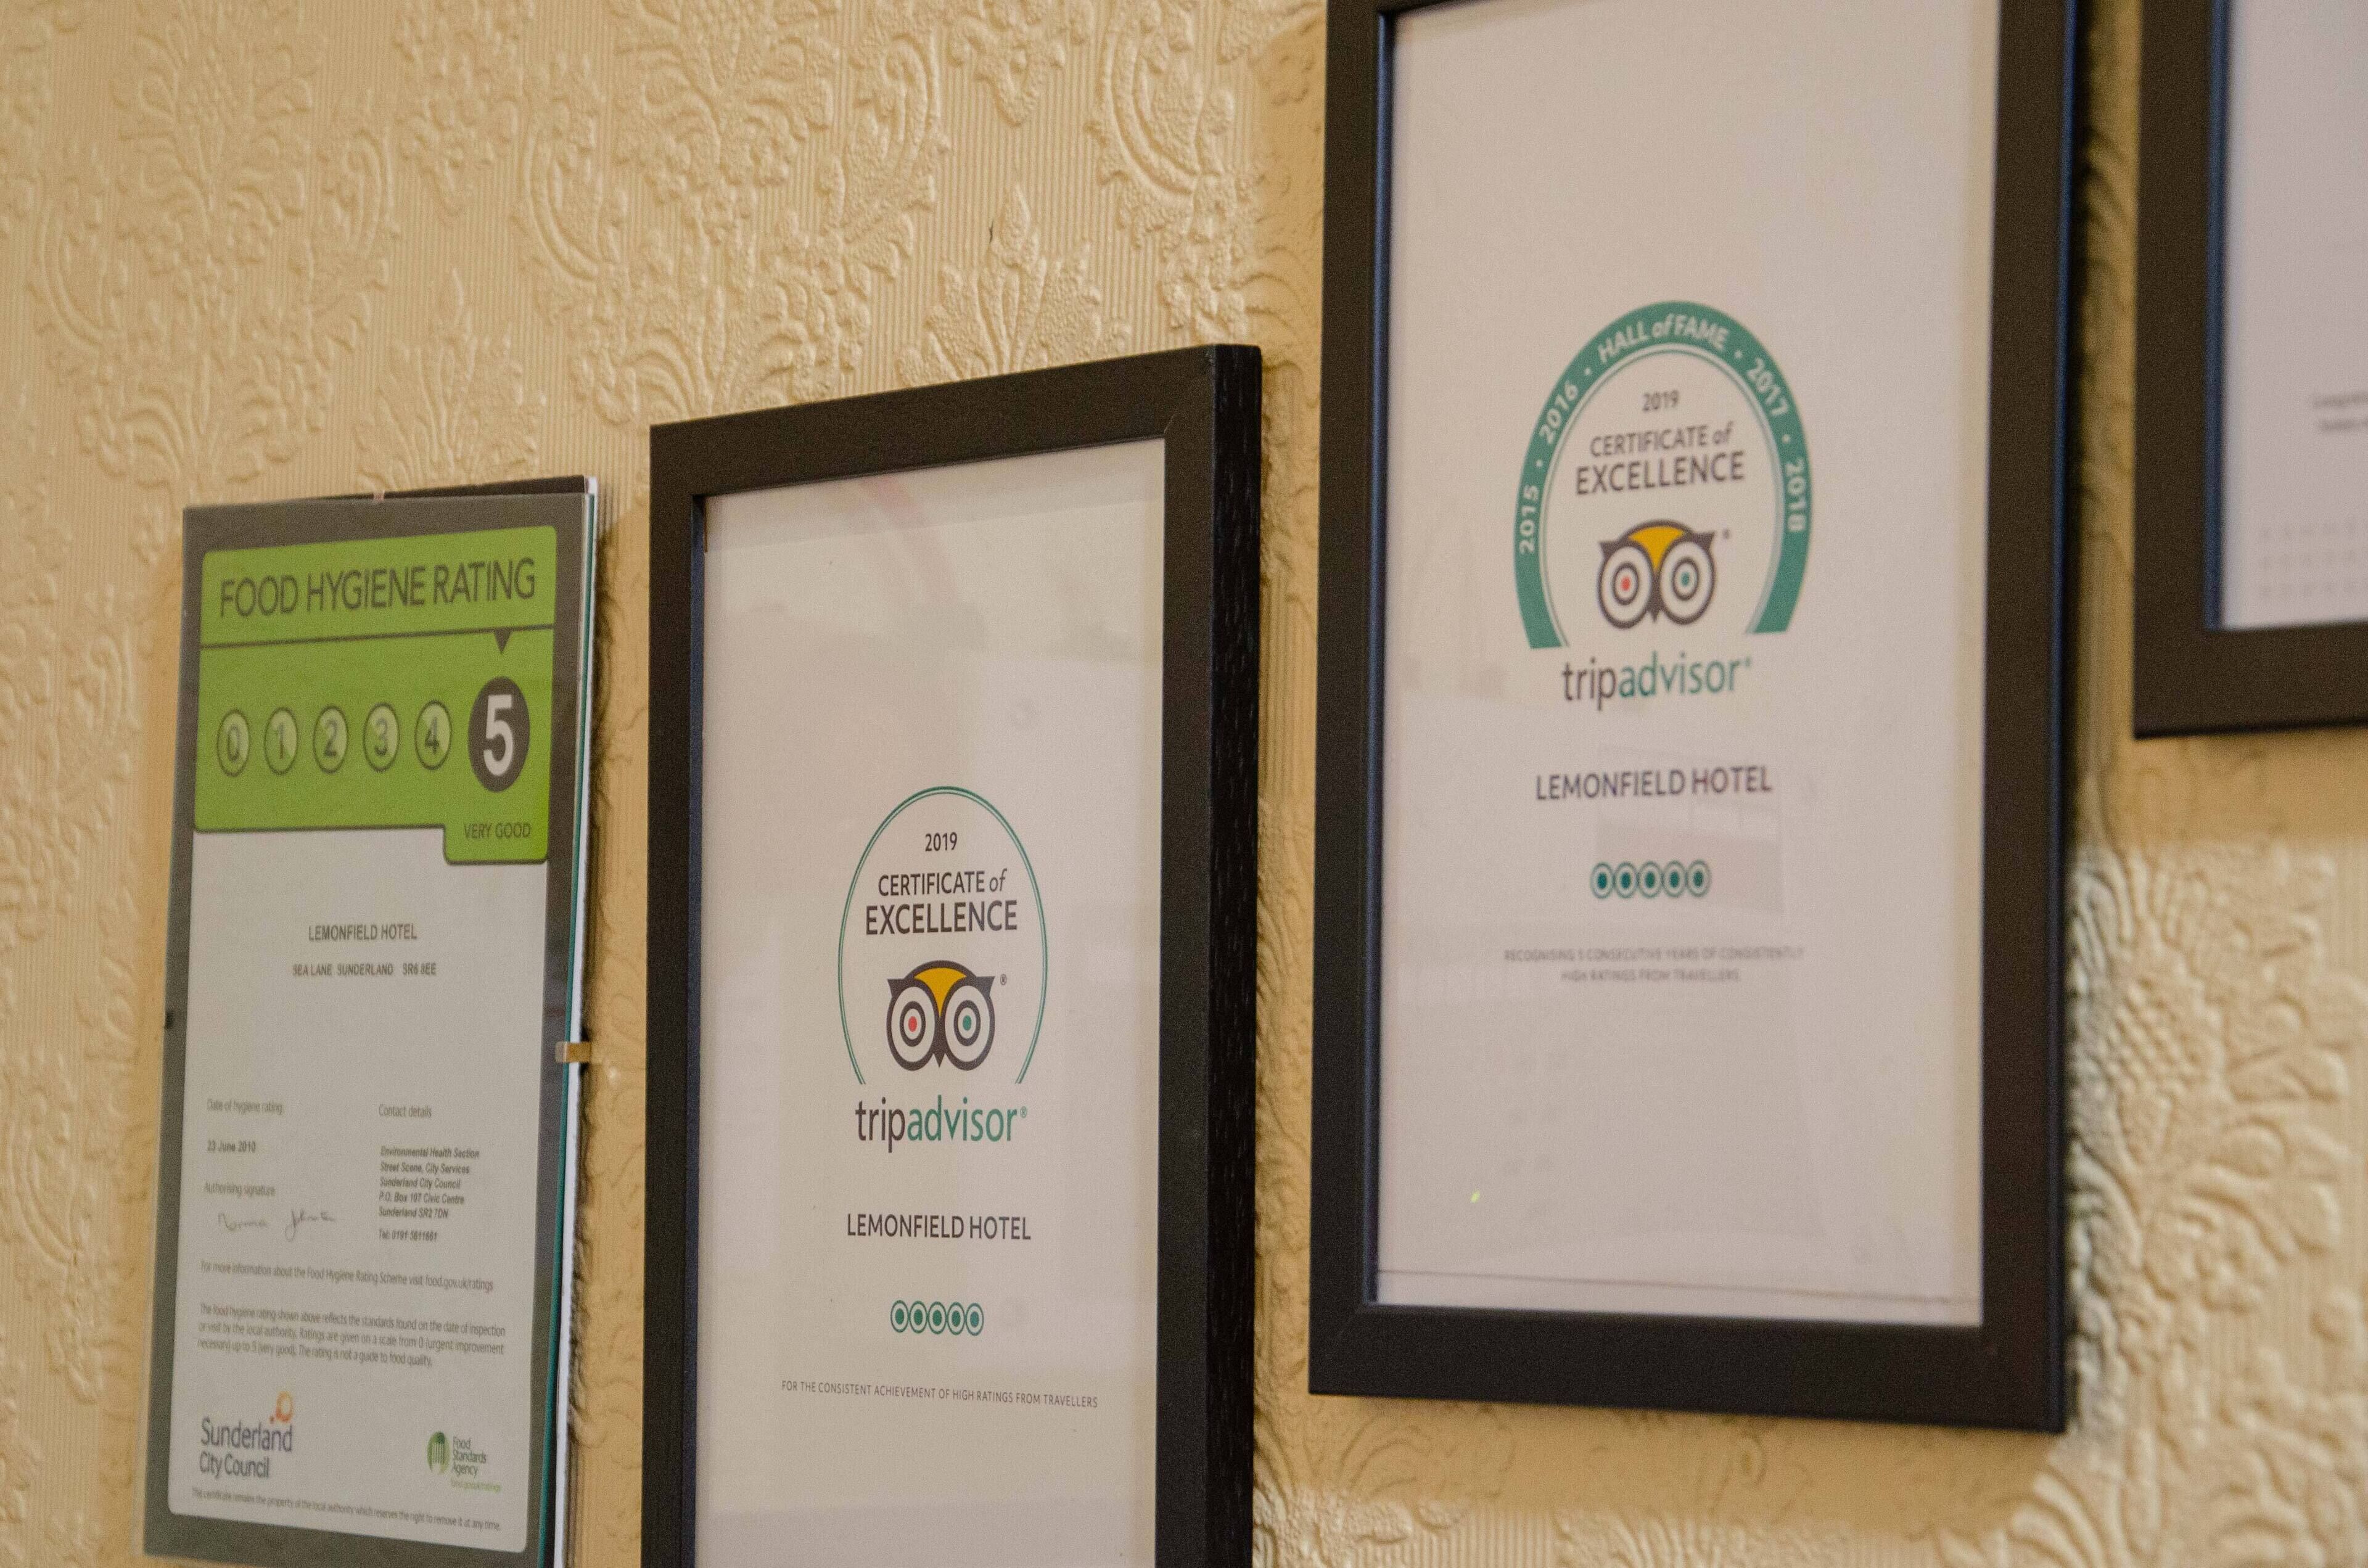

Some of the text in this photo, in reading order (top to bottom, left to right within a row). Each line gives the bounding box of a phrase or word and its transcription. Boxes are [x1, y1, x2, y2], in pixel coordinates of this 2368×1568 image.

[1642, 390, 1679, 411] 2019
[1519, 313, 1807, 553] 2015 2016 HALL of FAME 2017 2018
[1590, 421, 1733, 457] CERTIFICATE of
[1577, 451, 1745, 495] EXCELLENCE
[221, 557, 536, 617] FOOD HYGIENE RATING
[483, 694, 514, 776] 5
[1536, 765, 1772, 800] LEMONFIELD HOTEL
[464, 821, 530, 839] VERY GOOD
[925, 832, 958, 852] 2019
[878, 868, 1008, 896] CERTIFICATE of
[866, 900, 1018, 935] EXCELLENCE
[308, 923, 417, 941] LEMONFIELD HOTEL
[293, 963, 308, 975] SEA
[311, 963, 332, 975] LANE
[337, 963, 393, 975] SUNDERLAND
[847, 1213, 1031, 1241] LEMONFIELD HOTEL
[782, 1381, 1098, 1408] FOR THE CONSISTENT ACHIEVEMENT OF HIGH RATINGS FROM TRAVELLERS
[200, 1416, 293, 1452] Sunderland
[453, 1436, 471, 1450] Food
[200, 1451, 269, 1480] City Council
